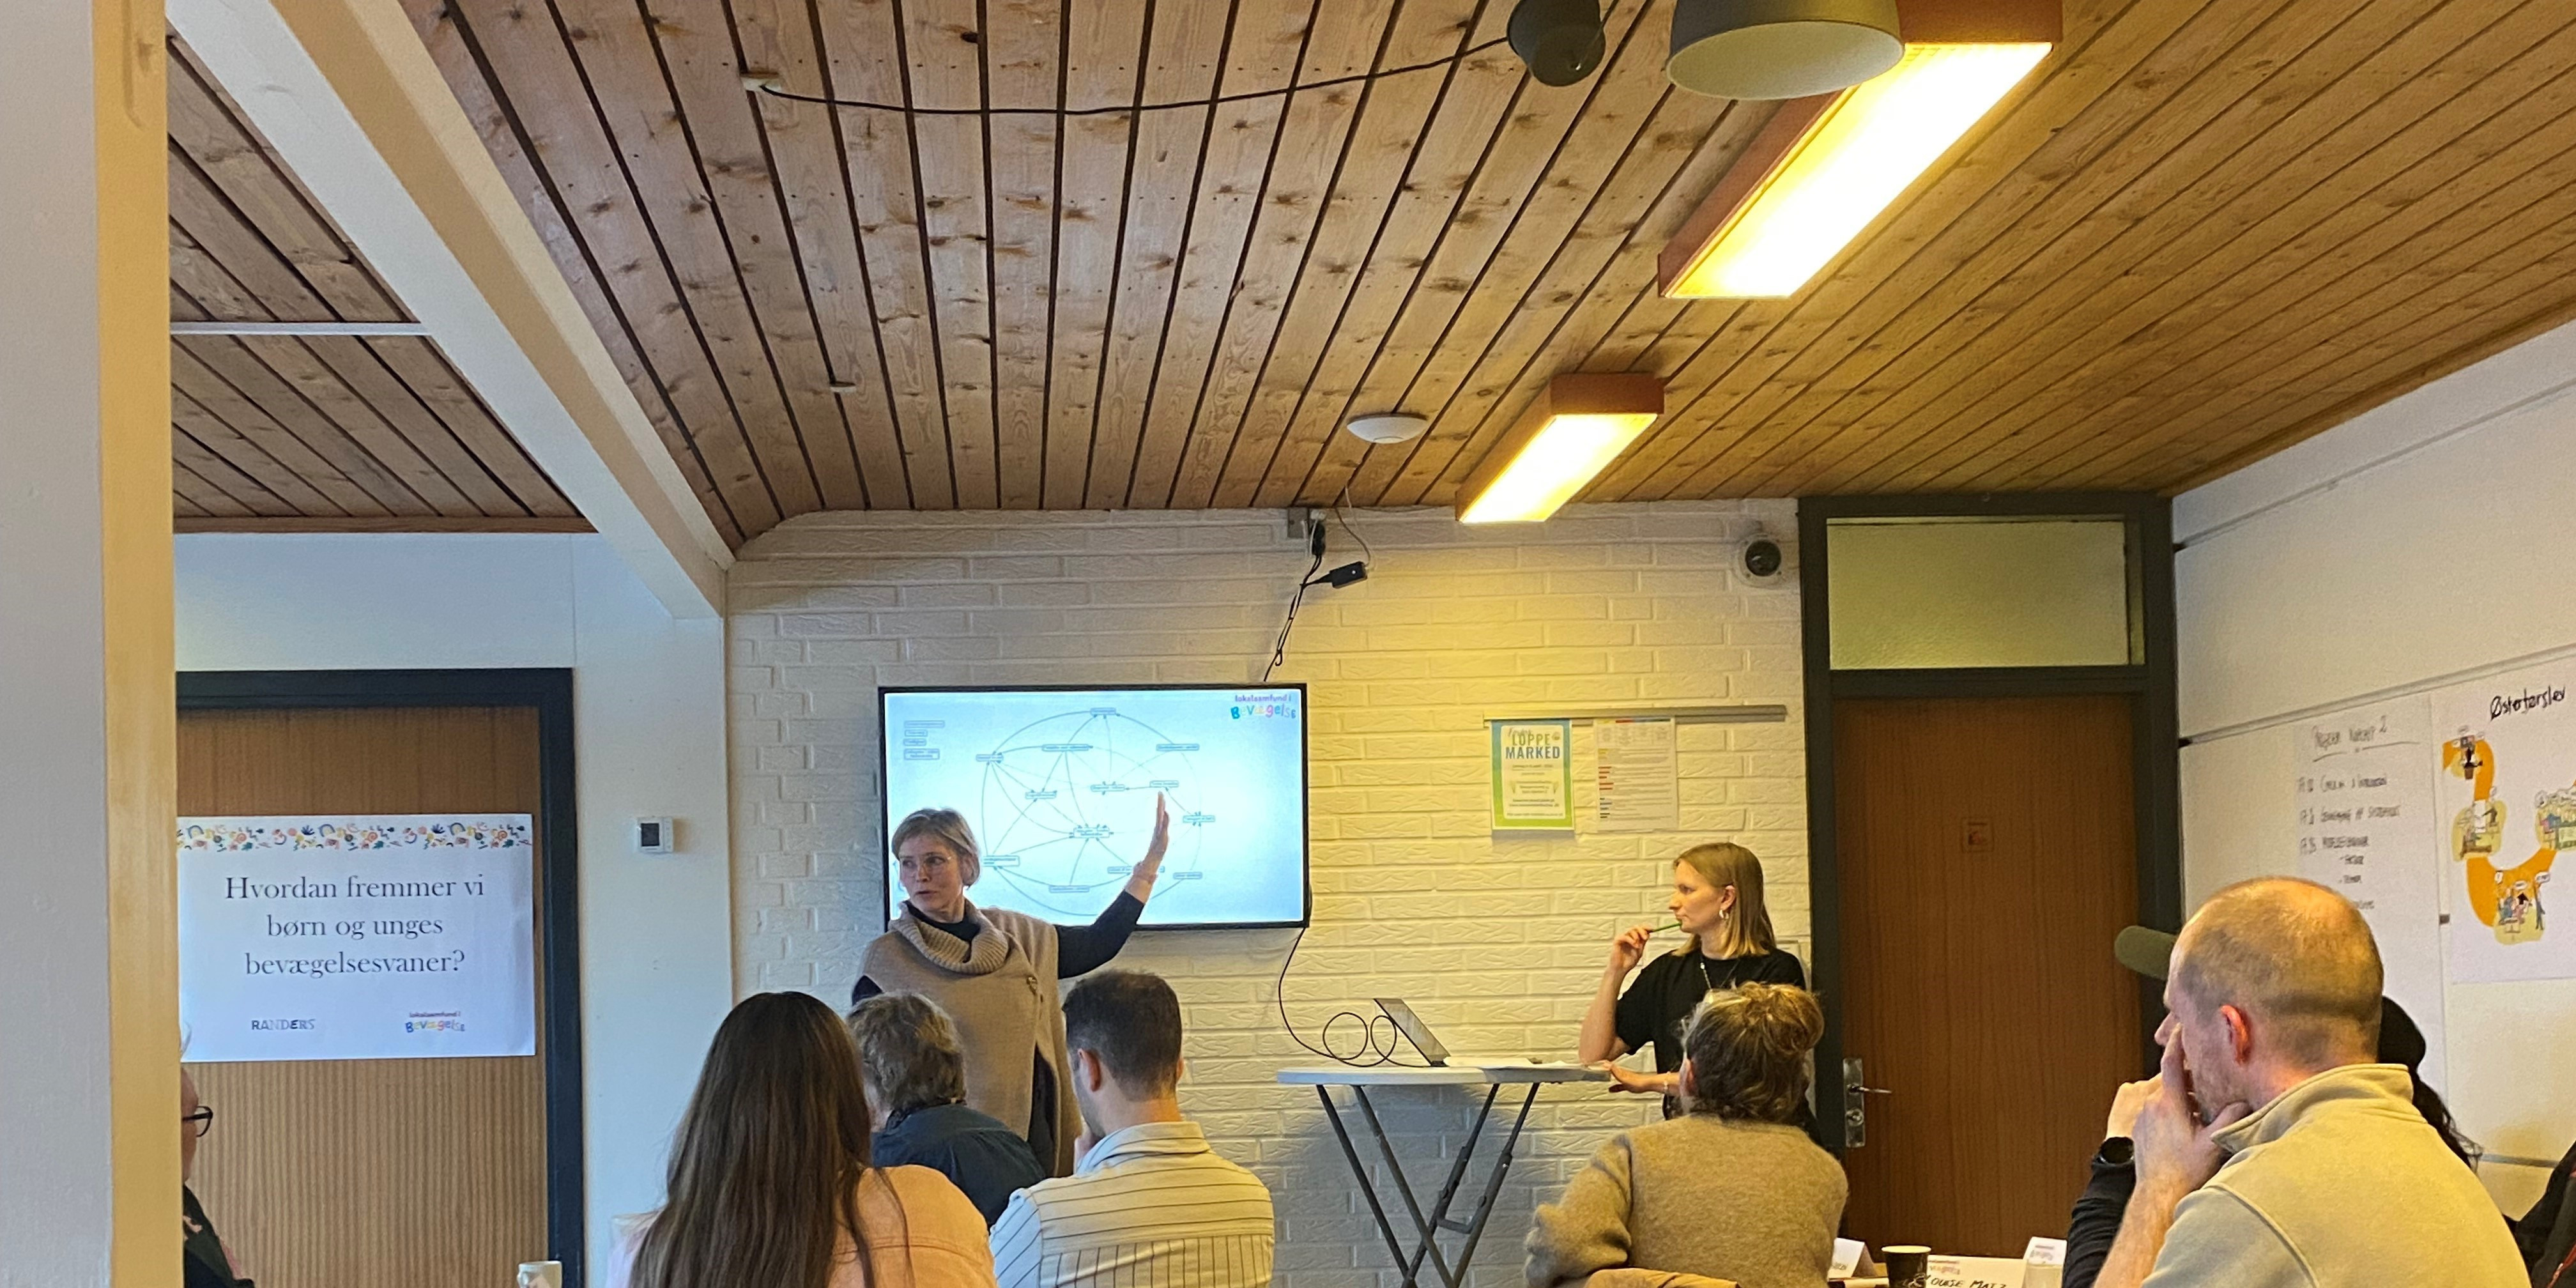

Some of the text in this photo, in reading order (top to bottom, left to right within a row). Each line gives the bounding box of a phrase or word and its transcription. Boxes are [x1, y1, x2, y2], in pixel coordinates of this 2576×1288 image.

[1512, 733, 1551, 746] LOPPE
[1505, 746, 1560, 759] MARKED
[226, 874, 484, 899] Hvordan fremmer vi
[266, 914, 443, 940] børn og unges
[245, 949, 465, 979] bevægelsesvaner?
[251, 1018, 316, 1031] RANDERS
